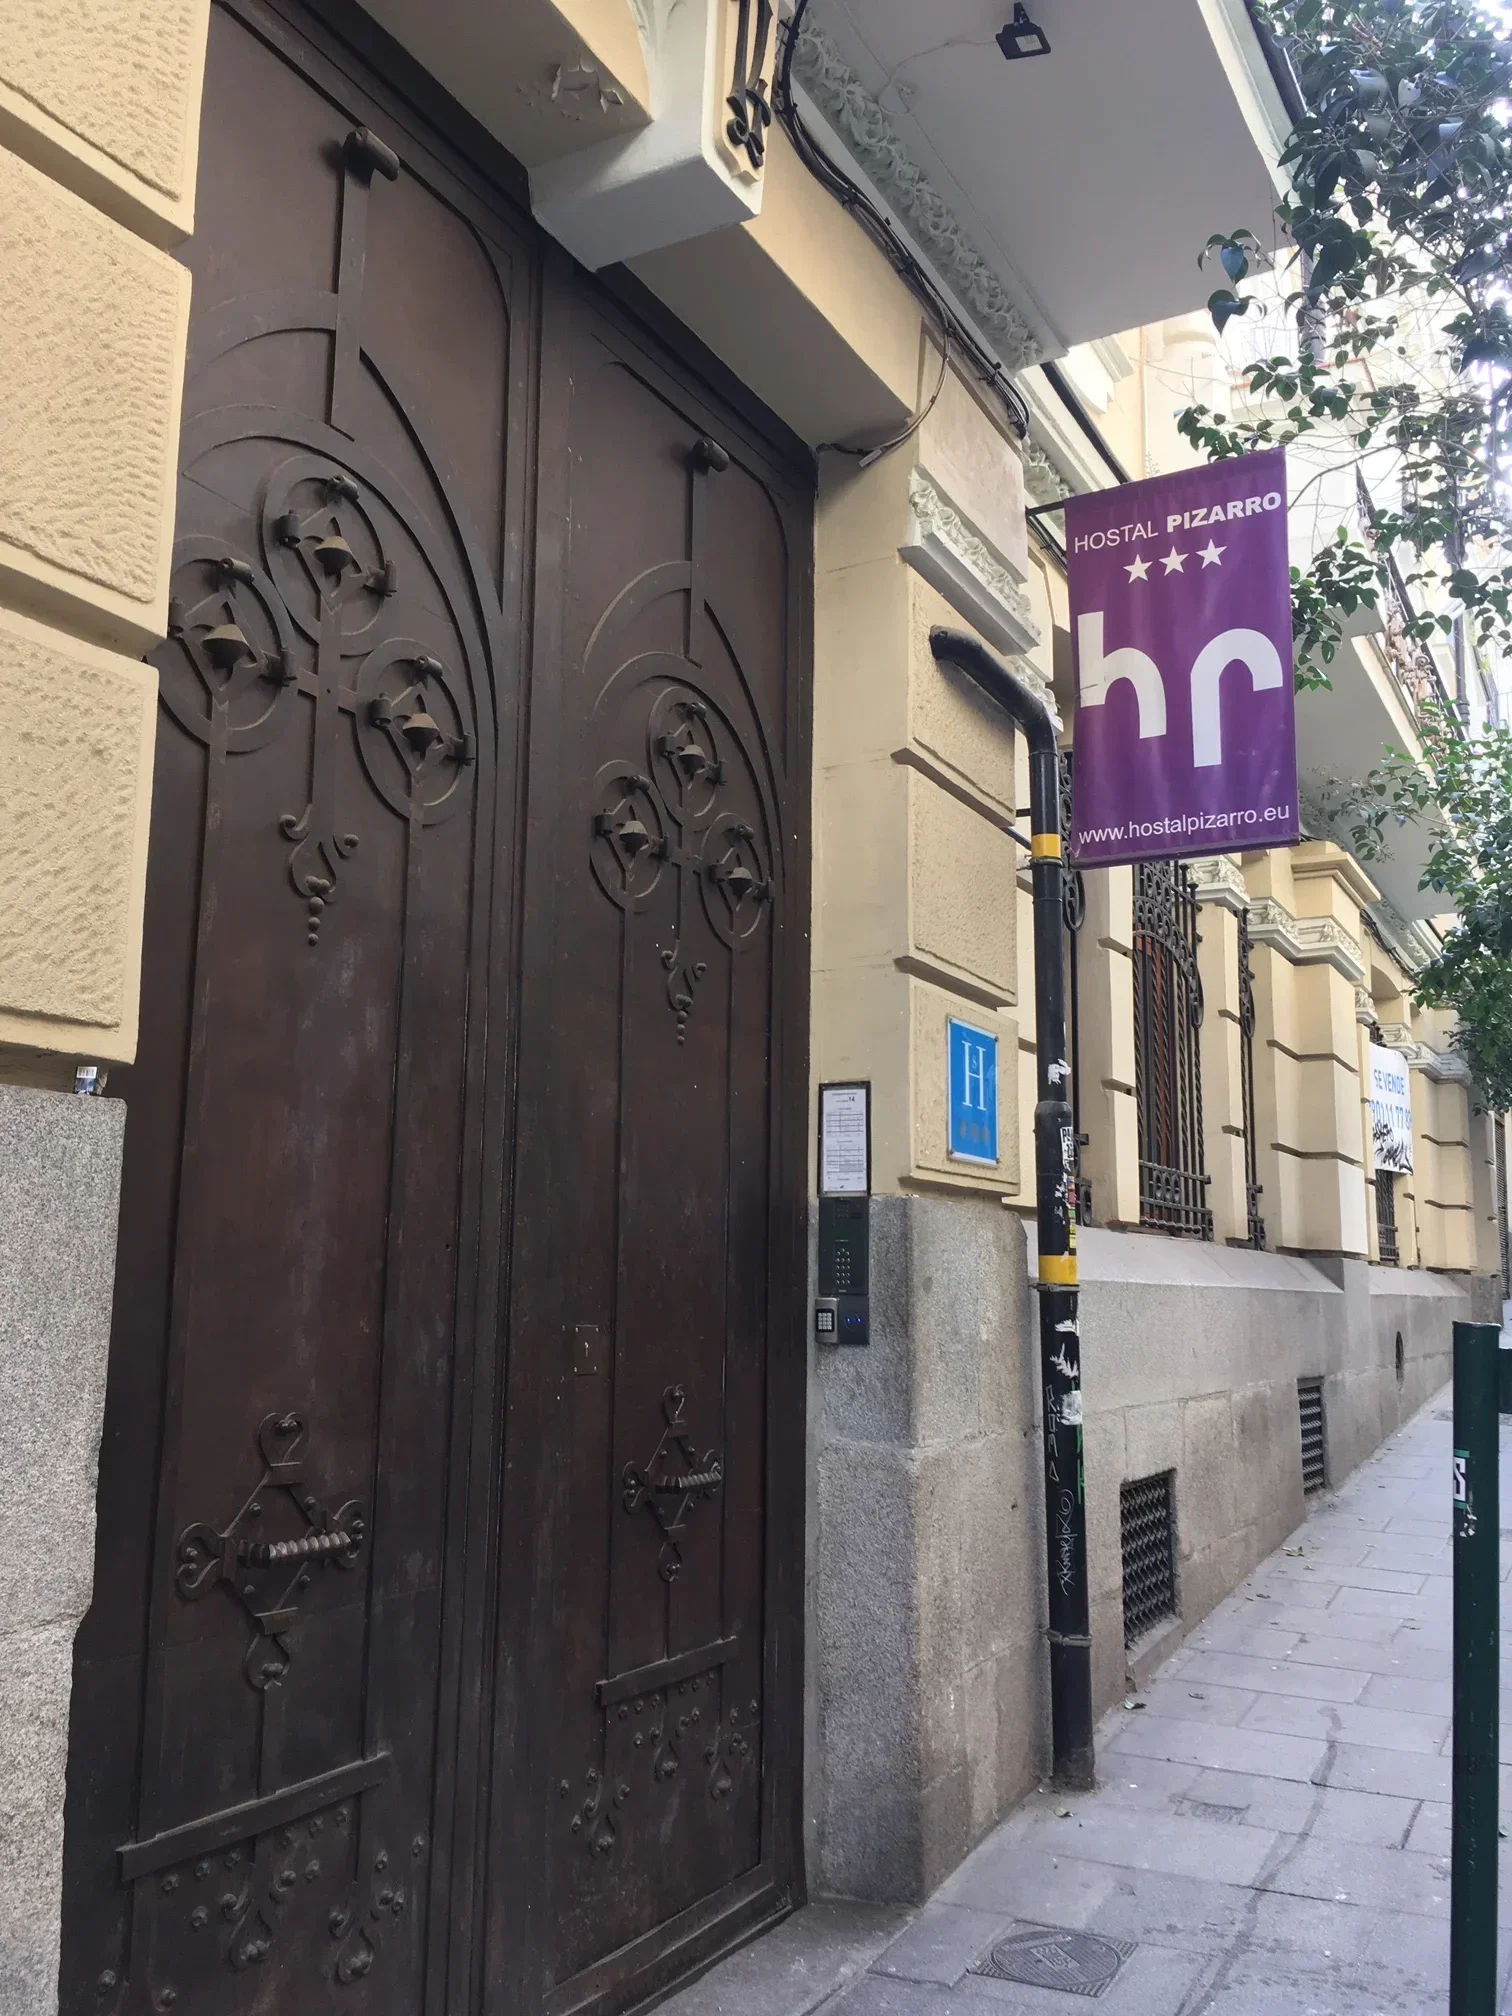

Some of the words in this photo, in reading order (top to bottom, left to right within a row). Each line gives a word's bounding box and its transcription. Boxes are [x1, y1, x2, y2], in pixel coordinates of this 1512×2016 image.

[1074, 519, 1159, 553] HOSTAL
[1166, 491, 1282, 533] PIZARRO
[1078, 804, 1290, 846] www.hostalpizarro.eu
[1373, 1068, 1383, 1090] SE
[1383, 1072, 1405, 1095] VENDE
